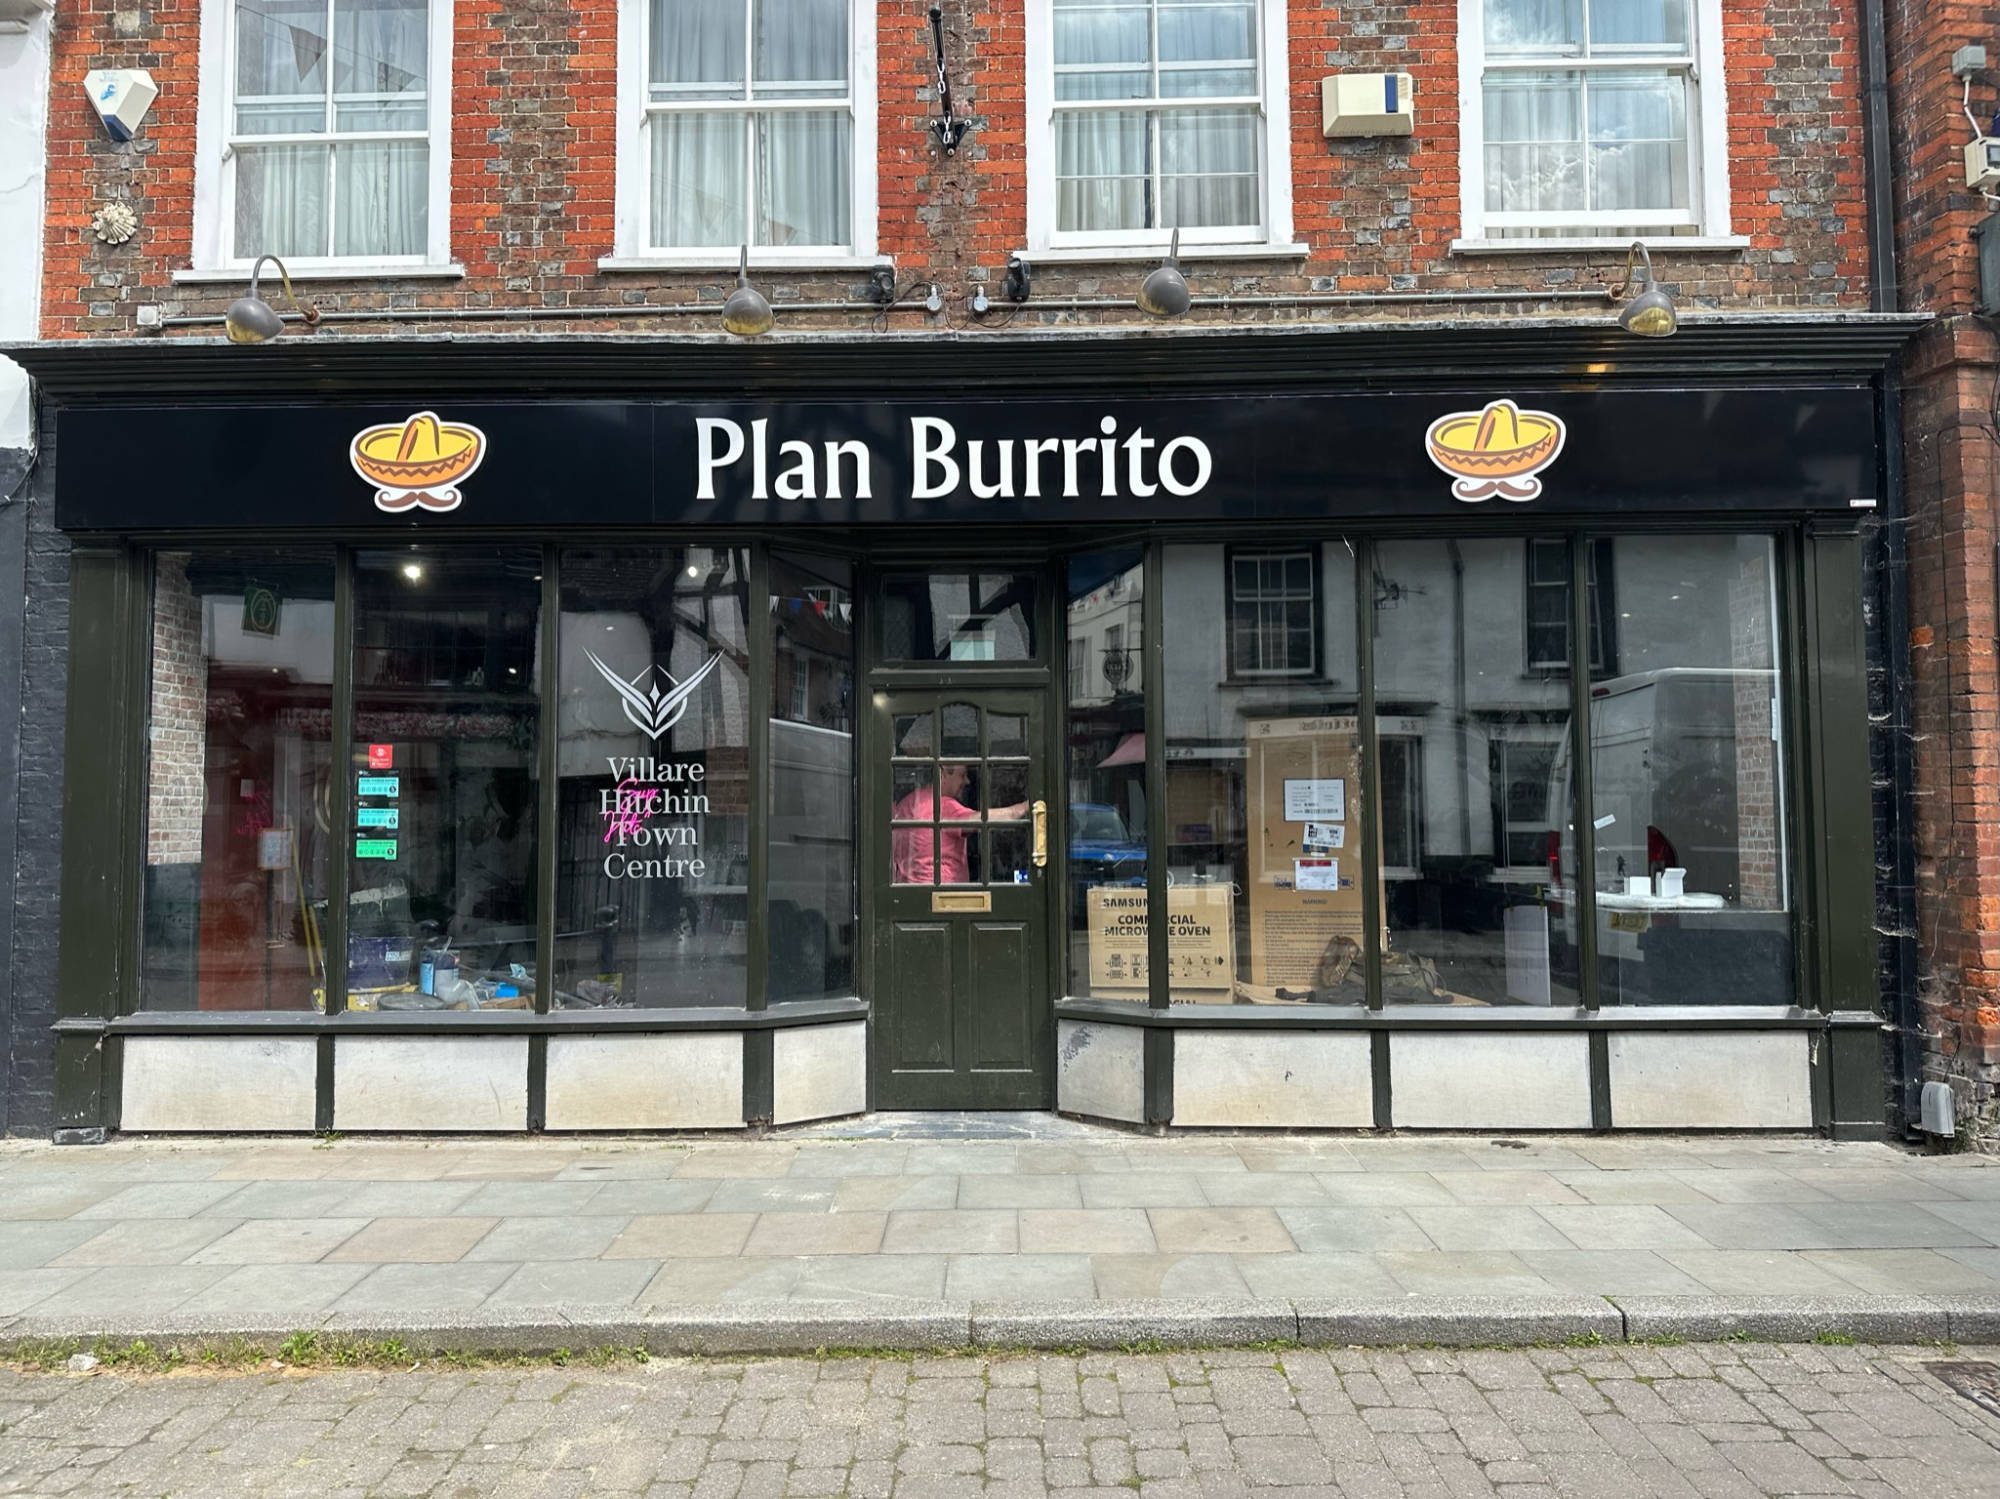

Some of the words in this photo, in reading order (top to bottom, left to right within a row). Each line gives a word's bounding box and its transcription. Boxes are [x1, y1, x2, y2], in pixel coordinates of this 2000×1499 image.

[695, 417, 872, 500] Plan
[910, 415, 1213, 499] Burrito
[606, 757, 705, 782] Villare
[599, 788, 711, 815] Hitchin
[612, 819, 699, 847] Town
[603, 853, 706, 879] Centre
[1103, 898, 1148, 908] SAMSUN
[1118, 914, 1197, 925] COMCIAL
[1178, 926, 1211, 936] OVEN
